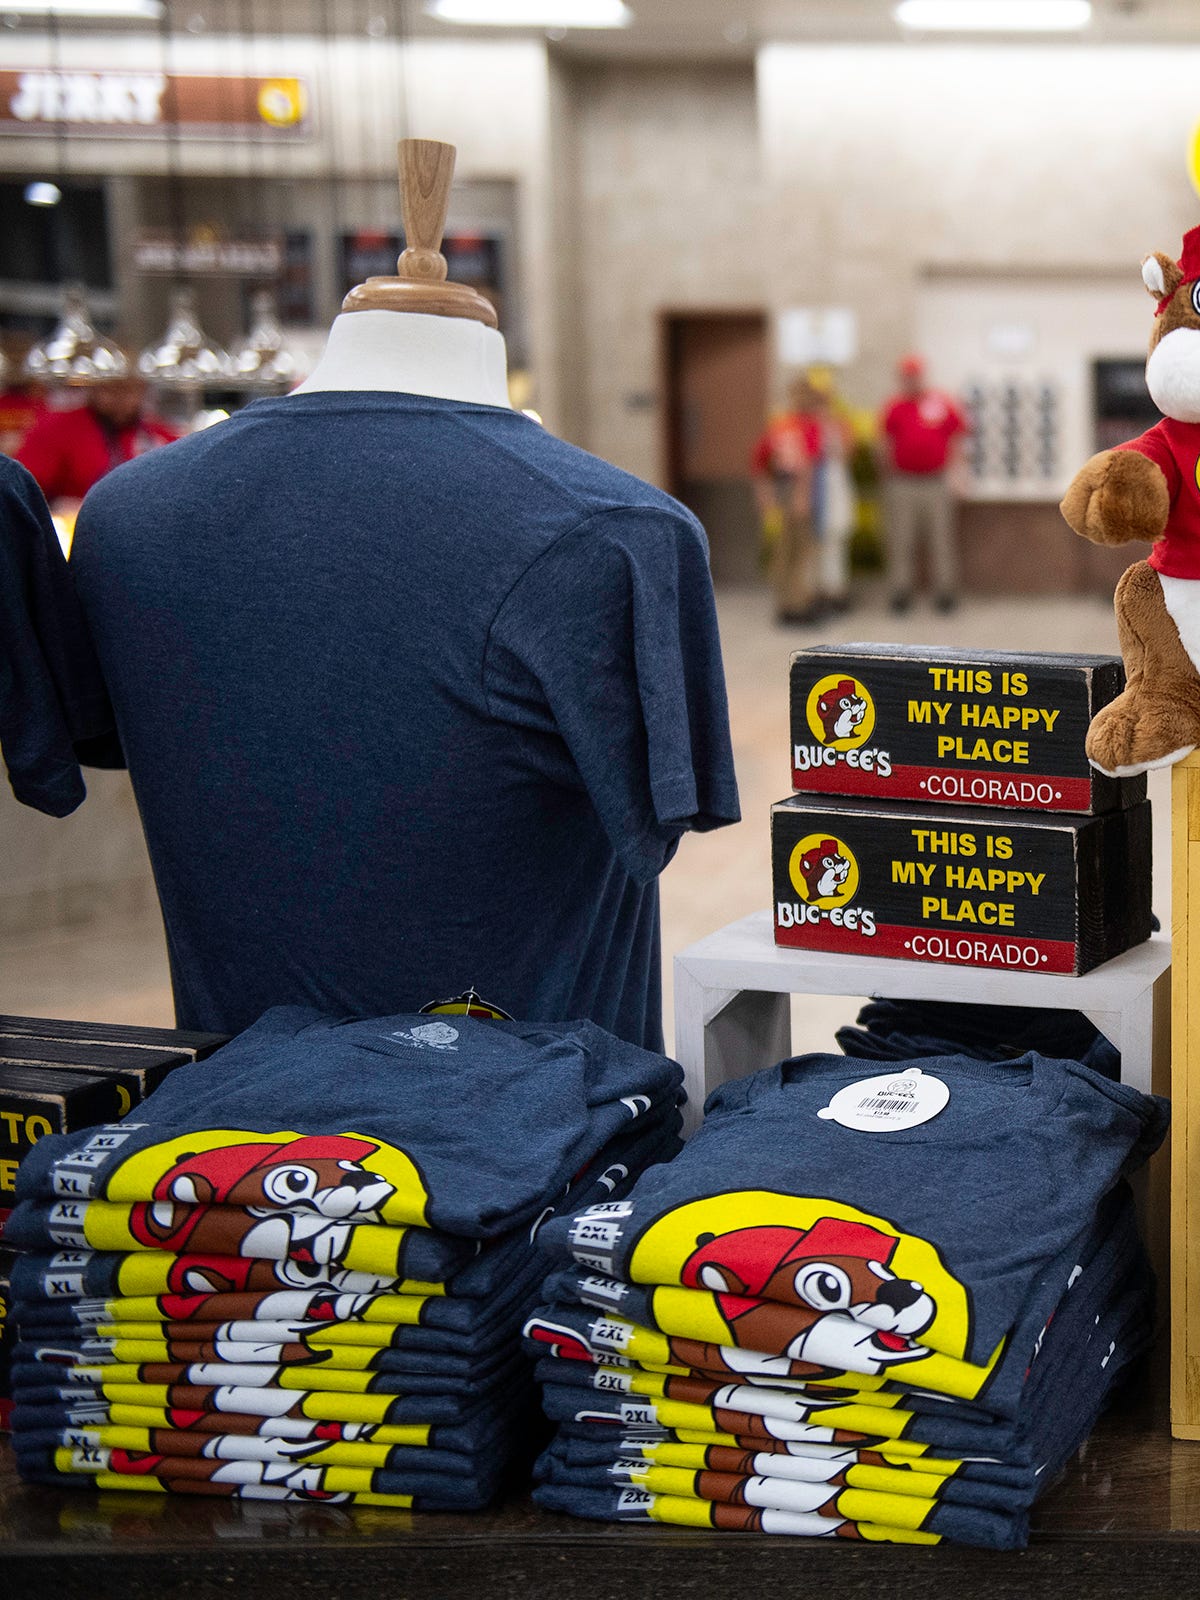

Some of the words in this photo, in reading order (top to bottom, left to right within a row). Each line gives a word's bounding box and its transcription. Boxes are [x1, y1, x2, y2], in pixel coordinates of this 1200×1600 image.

[928, 667, 993, 694] THIS
[1002, 672, 1028, 696] IS
[907, 700, 952, 725] MY
[961, 703, 1060, 732] HAPPY
[937, 735, 1029, 764] PLACE
[794, 744, 892, 777] BUC-EE'S
[911, 829, 977, 857] THIS
[986, 835, 1013, 860] IS
[891, 860, 937, 886] MY
[945, 865, 1046, 896] HAPPY
[777, 902, 877, 937] BUC-EE'S
[922, 896, 1015, 927] PLACE
[0, 1111, 52, 1145] TO
[60, 1178, 83, 1193] XL
[57, 1205, 79, 1218] XL
[593, 1204, 622, 1213] 2XL
[51, 1281, 77, 1295] XL
[596, 1324, 624, 1342] 2XL
[598, 1353, 625, 1368] 2XL
[598, 1375, 626, 1391] 2XL
[624, 1410, 653, 1424] 2XL
[80, 1448, 103, 1463] XL
[623, 1492, 651, 1504] 2XL
